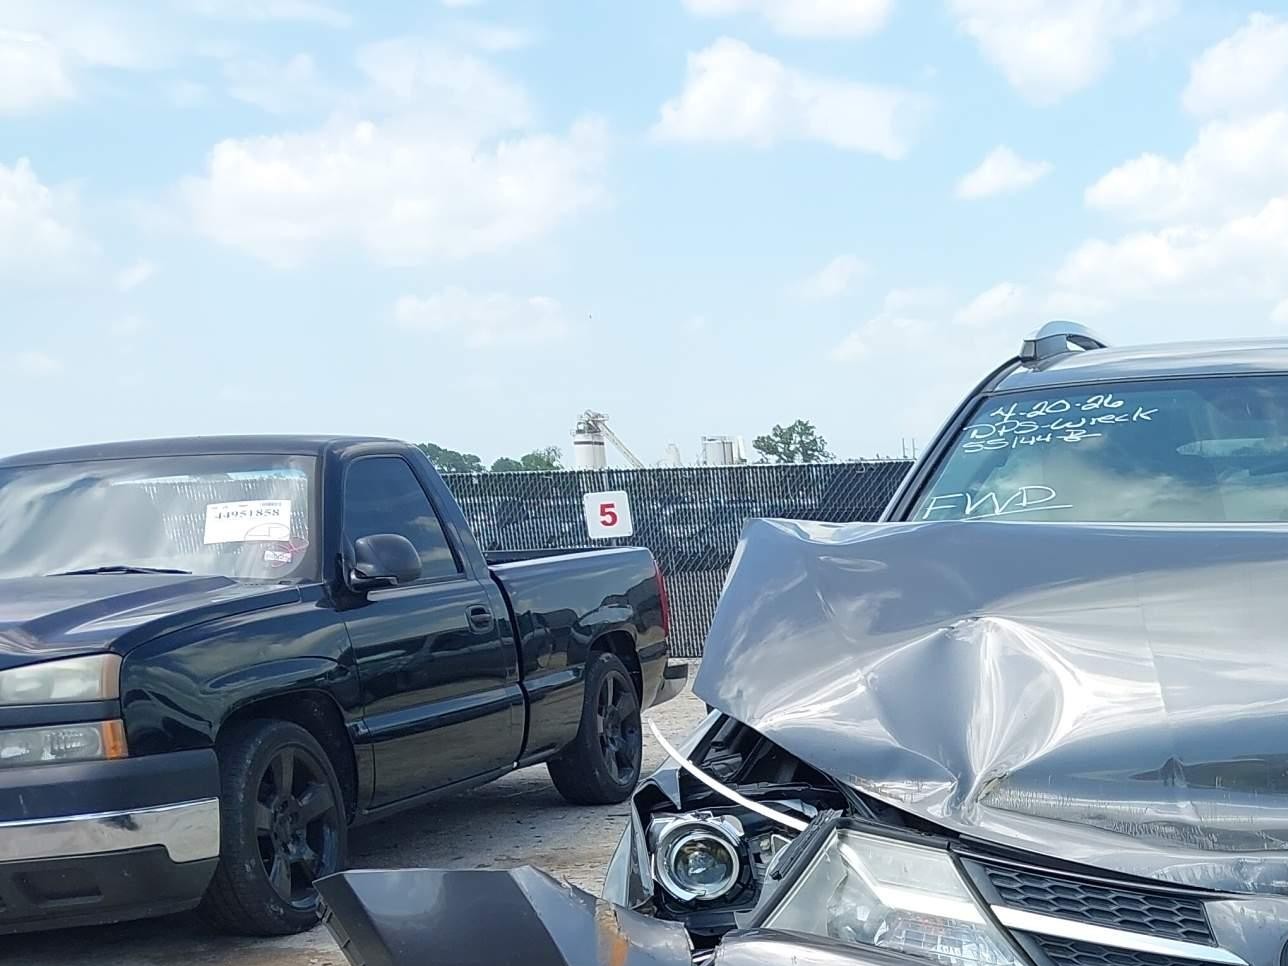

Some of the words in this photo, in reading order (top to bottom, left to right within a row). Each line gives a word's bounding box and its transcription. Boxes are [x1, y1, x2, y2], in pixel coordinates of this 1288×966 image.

[990, 394, 1124, 422] 4-20-26
[215, 509, 280, 520] 44951858
[599, 503, 618, 527] 5
[922, 485, 1056, 520] FWD
